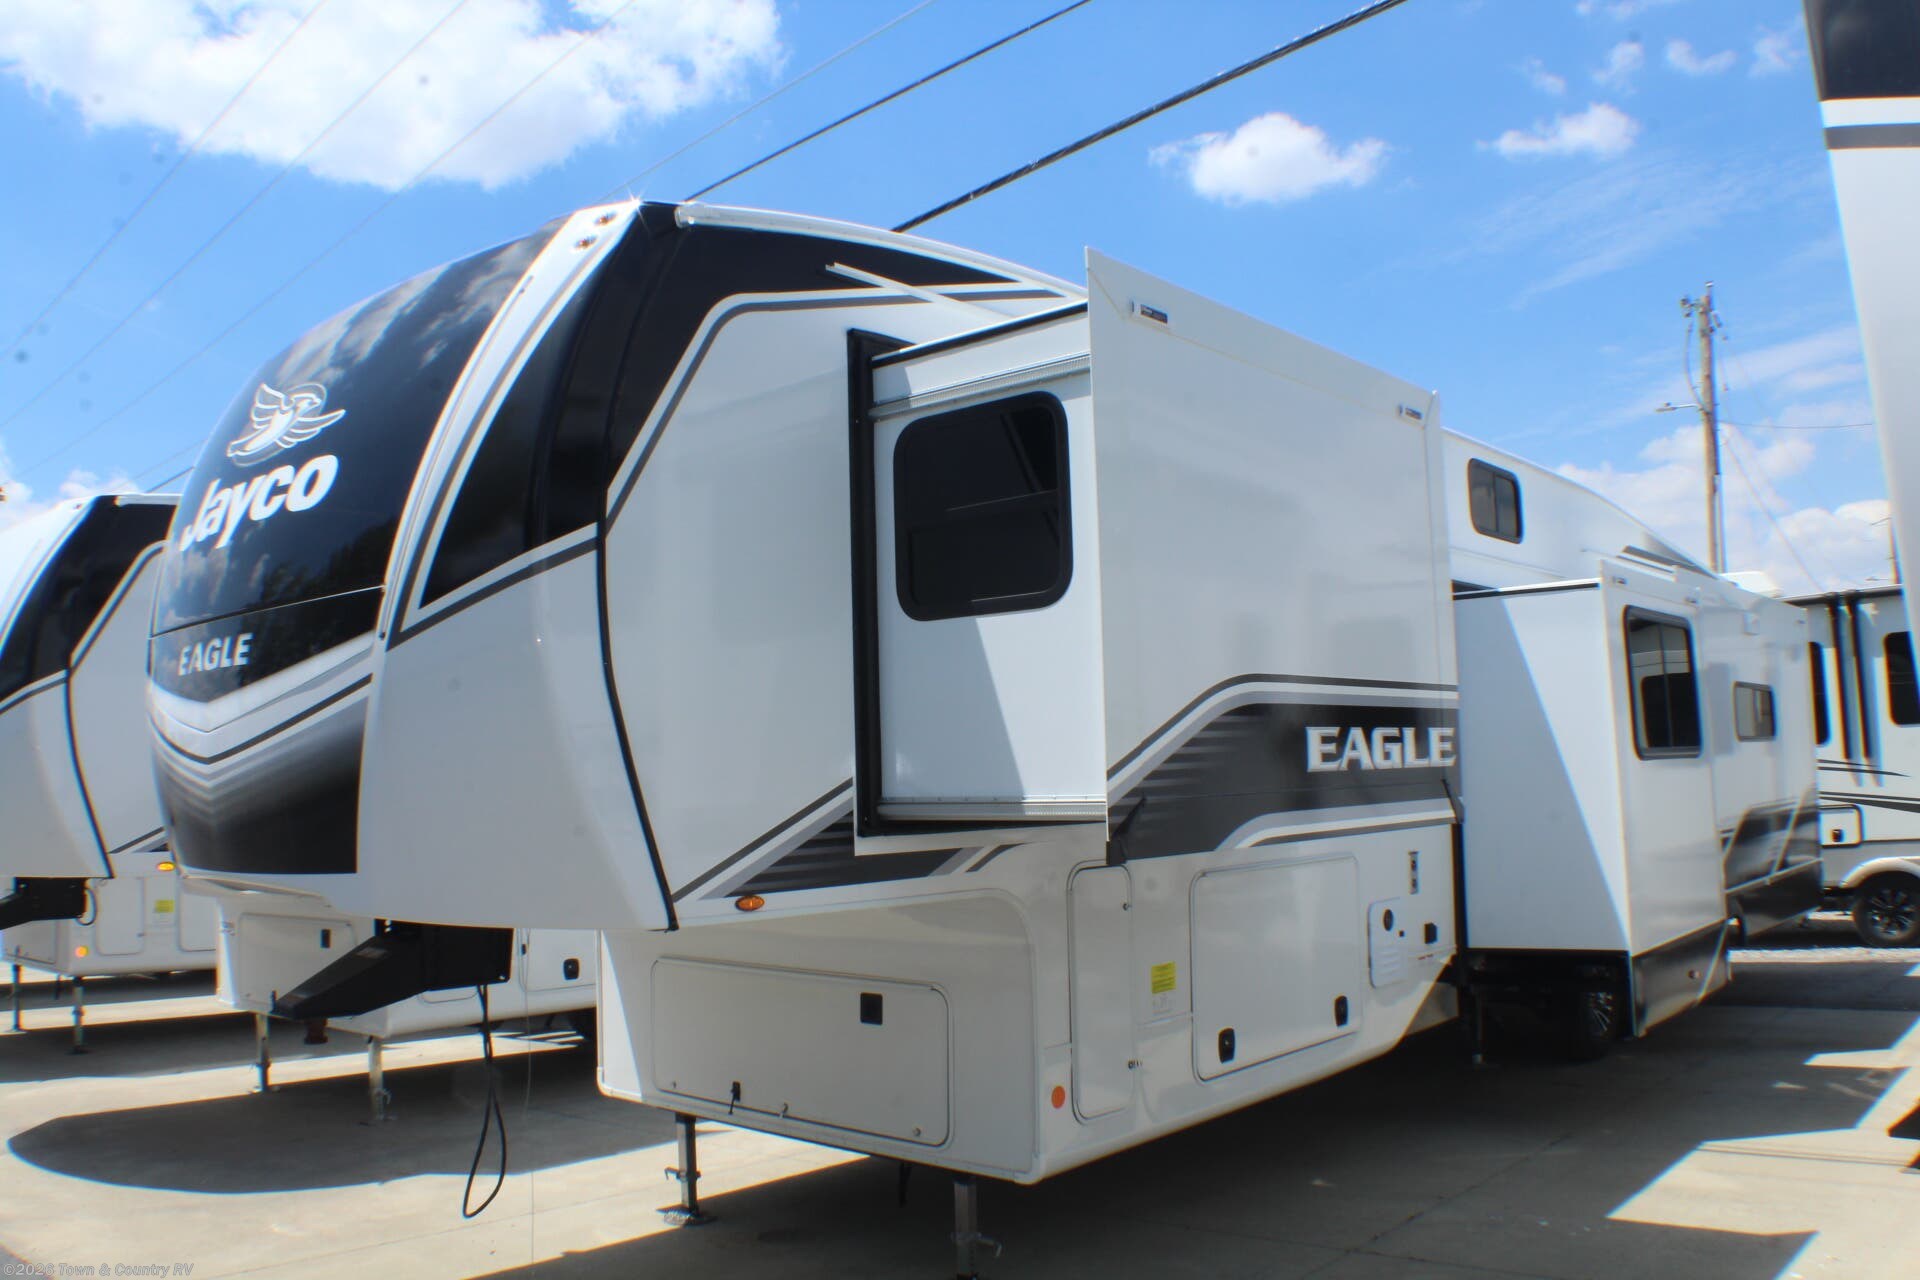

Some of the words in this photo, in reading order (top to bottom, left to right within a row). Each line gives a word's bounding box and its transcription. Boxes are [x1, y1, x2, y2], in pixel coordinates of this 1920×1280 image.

[178, 454, 339, 551] Jayco
[178, 633, 254, 676] EAGLE
[1305, 726, 1457, 773] EAGLE
